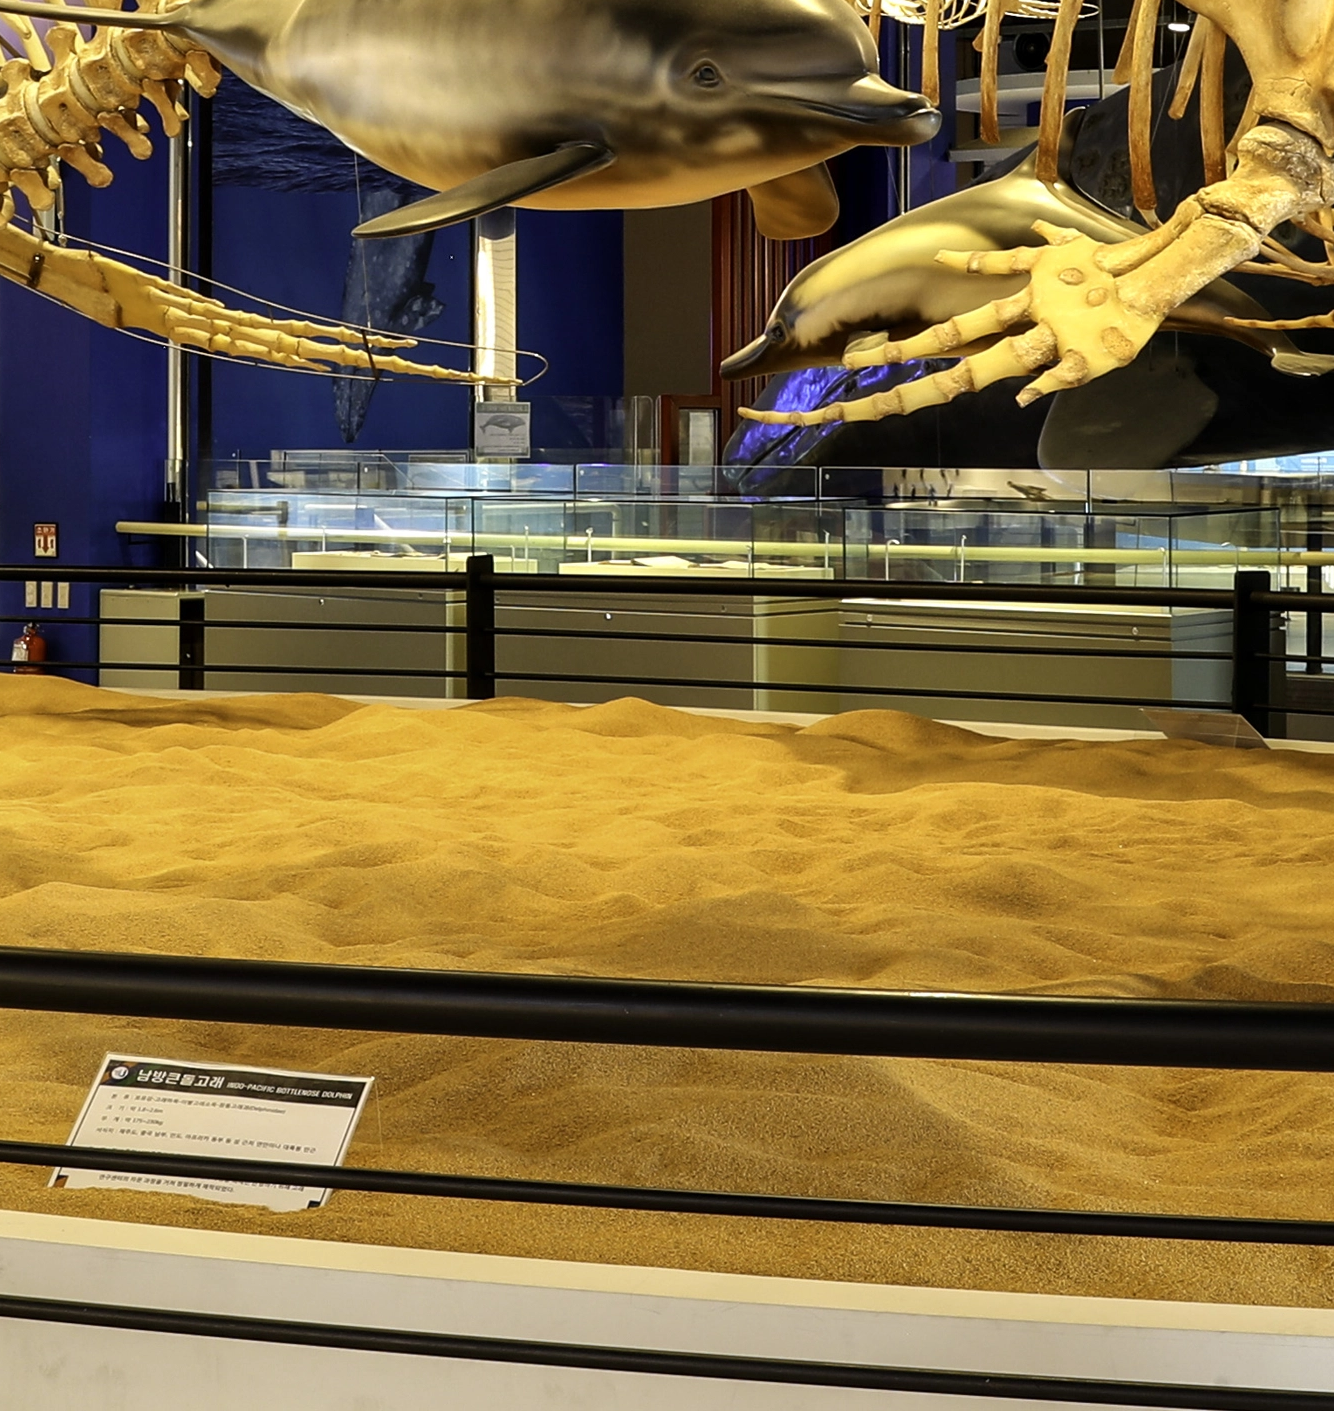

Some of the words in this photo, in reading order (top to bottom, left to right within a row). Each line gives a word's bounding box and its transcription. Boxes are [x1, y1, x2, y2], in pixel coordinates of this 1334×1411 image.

[136, 1069, 225, 1089] 남방큰돌고래
[226, 1082, 275, 1093] INDO-PACIFIC
[276, 1087, 321, 1098] BOTTLENOSE
[321, 1091, 354, 1100] DOLPHIN
